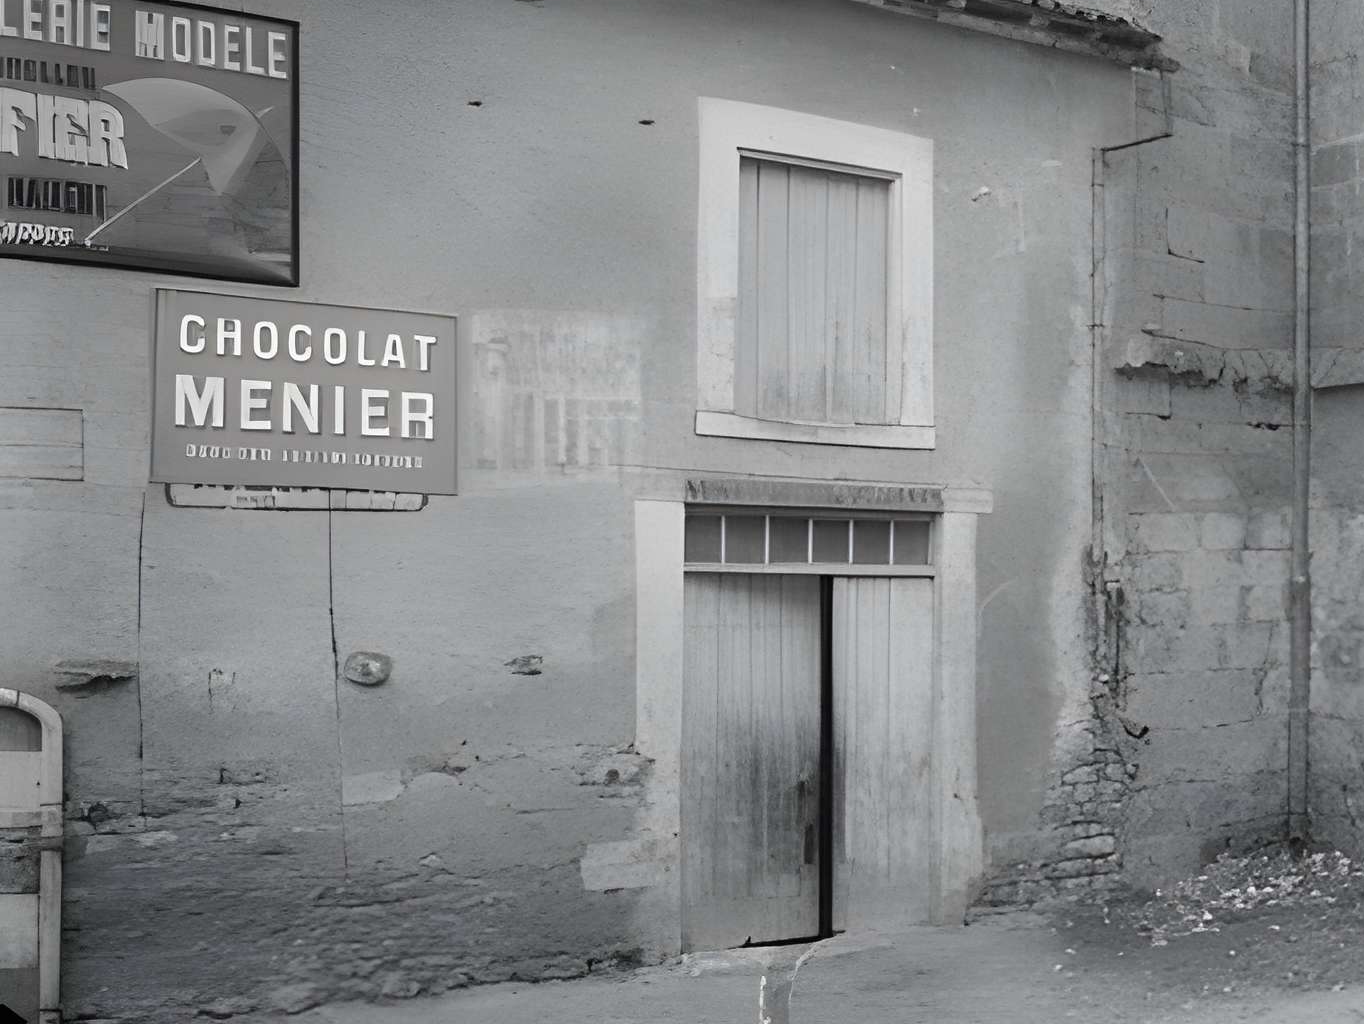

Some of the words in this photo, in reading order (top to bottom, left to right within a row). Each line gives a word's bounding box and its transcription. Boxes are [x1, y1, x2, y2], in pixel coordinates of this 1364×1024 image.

[135, 9, 288, 80] MODELE
[179, 314, 437, 372] CHOCOLAT
[174, 374, 435, 441] MENIER
